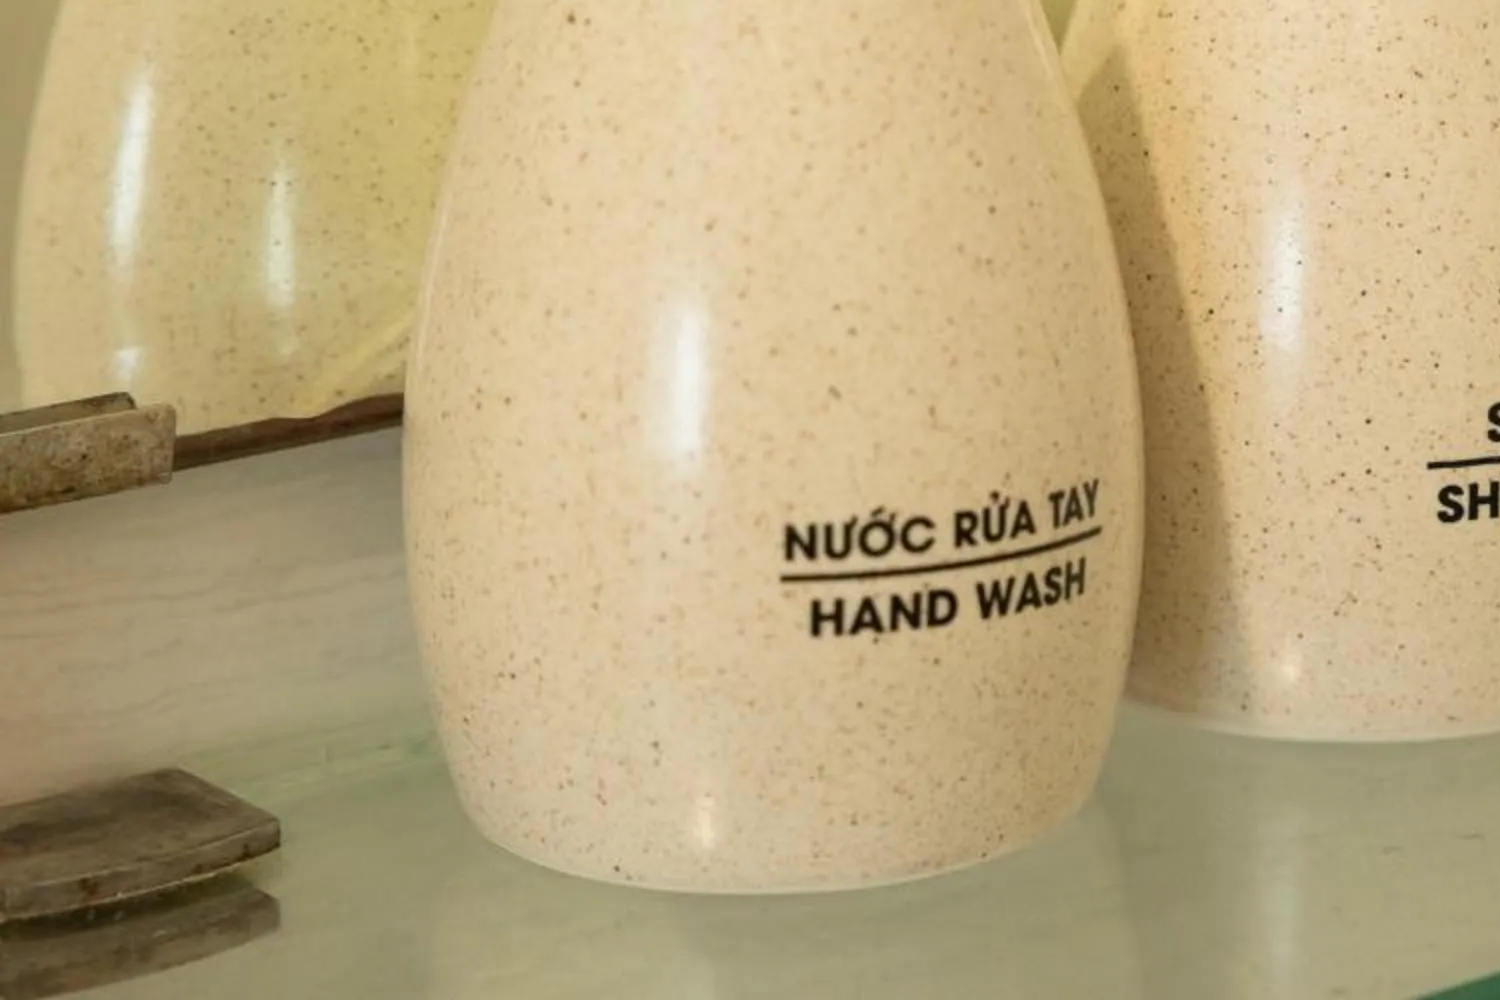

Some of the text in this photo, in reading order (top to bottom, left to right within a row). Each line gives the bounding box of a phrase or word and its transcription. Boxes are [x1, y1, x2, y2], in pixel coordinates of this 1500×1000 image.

[784, 478, 1099, 561] NƯỚC RỬA TAY
[810, 556, 1086, 637] HAND WASH
